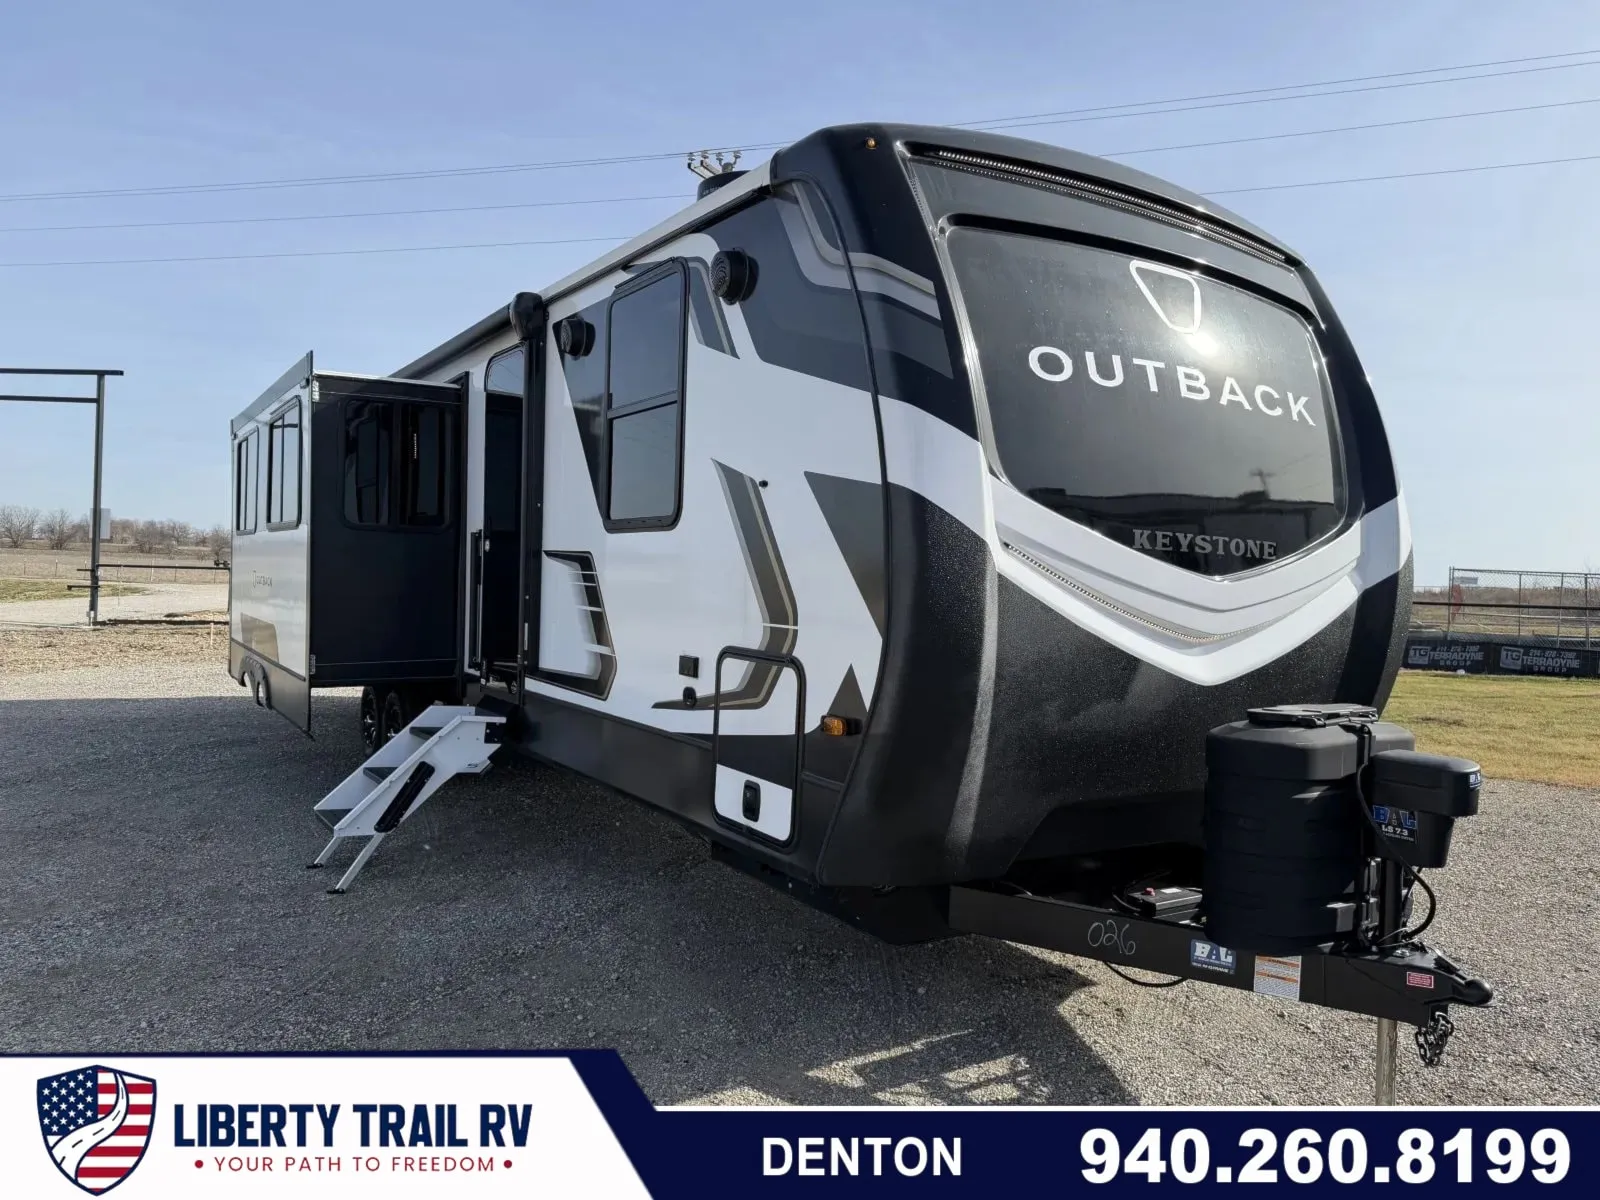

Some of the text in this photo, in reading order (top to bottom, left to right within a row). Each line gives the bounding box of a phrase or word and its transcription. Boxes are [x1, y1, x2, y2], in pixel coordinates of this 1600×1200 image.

[1028, 346, 1316, 426] OUTBACK
[1132, 529, 1277, 560] KEYSTONE
[1430, 651, 1485, 660] TERRADYNE
[1522, 655, 1580, 669] TERRADYNE
[1381, 824, 1394, 833] LS
[1088, 919, 1136, 955] 026
[1194, 942, 1233, 963] BAL
